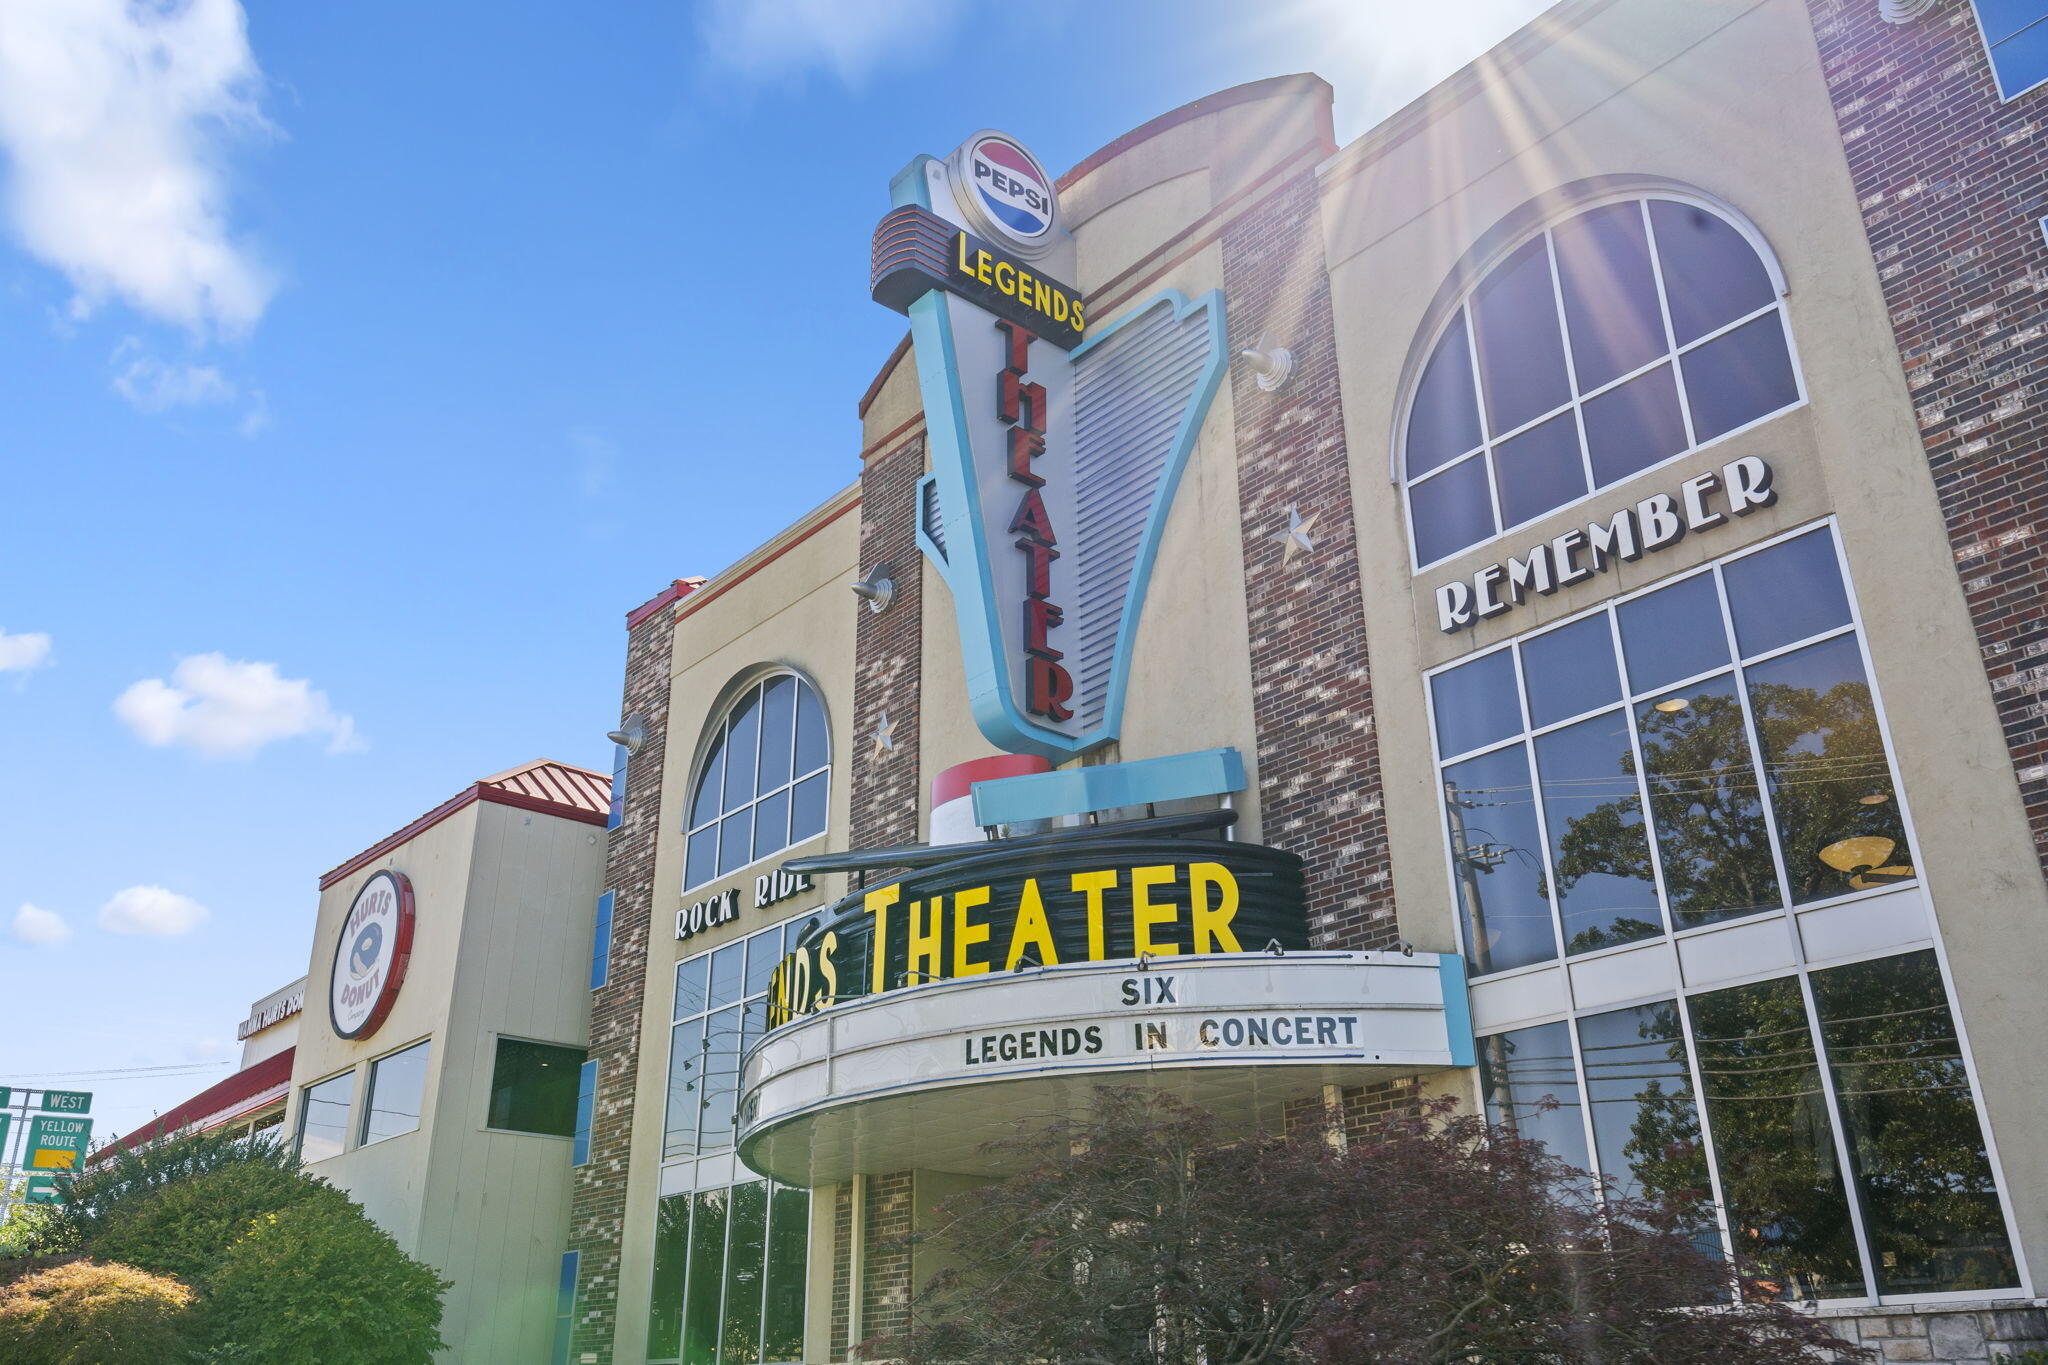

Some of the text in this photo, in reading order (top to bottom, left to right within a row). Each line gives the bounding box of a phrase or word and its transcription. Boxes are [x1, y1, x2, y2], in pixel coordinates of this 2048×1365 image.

[974, 158, 1049, 216] PEPSI
[959, 230, 1085, 333] LEGENDS
[997, 317, 1074, 723] THEATER
[1435, 455, 1776, 634] REMEMBER
[349, 889, 391, 938] HURTS
[674, 888, 738, 941] ROCK
[864, 862, 1242, 994] THEATER
[341, 968, 380, 1007] DONUT
[1121, 976, 1176, 1006] SIX
[965, 1016, 1358, 1066] LEGENDS IN CONCERT
[40, 1120, 84, 1133] YELLOW
[50, 1094, 85, 1110] WEST
[40, 1134, 77, 1147] ROUTE
